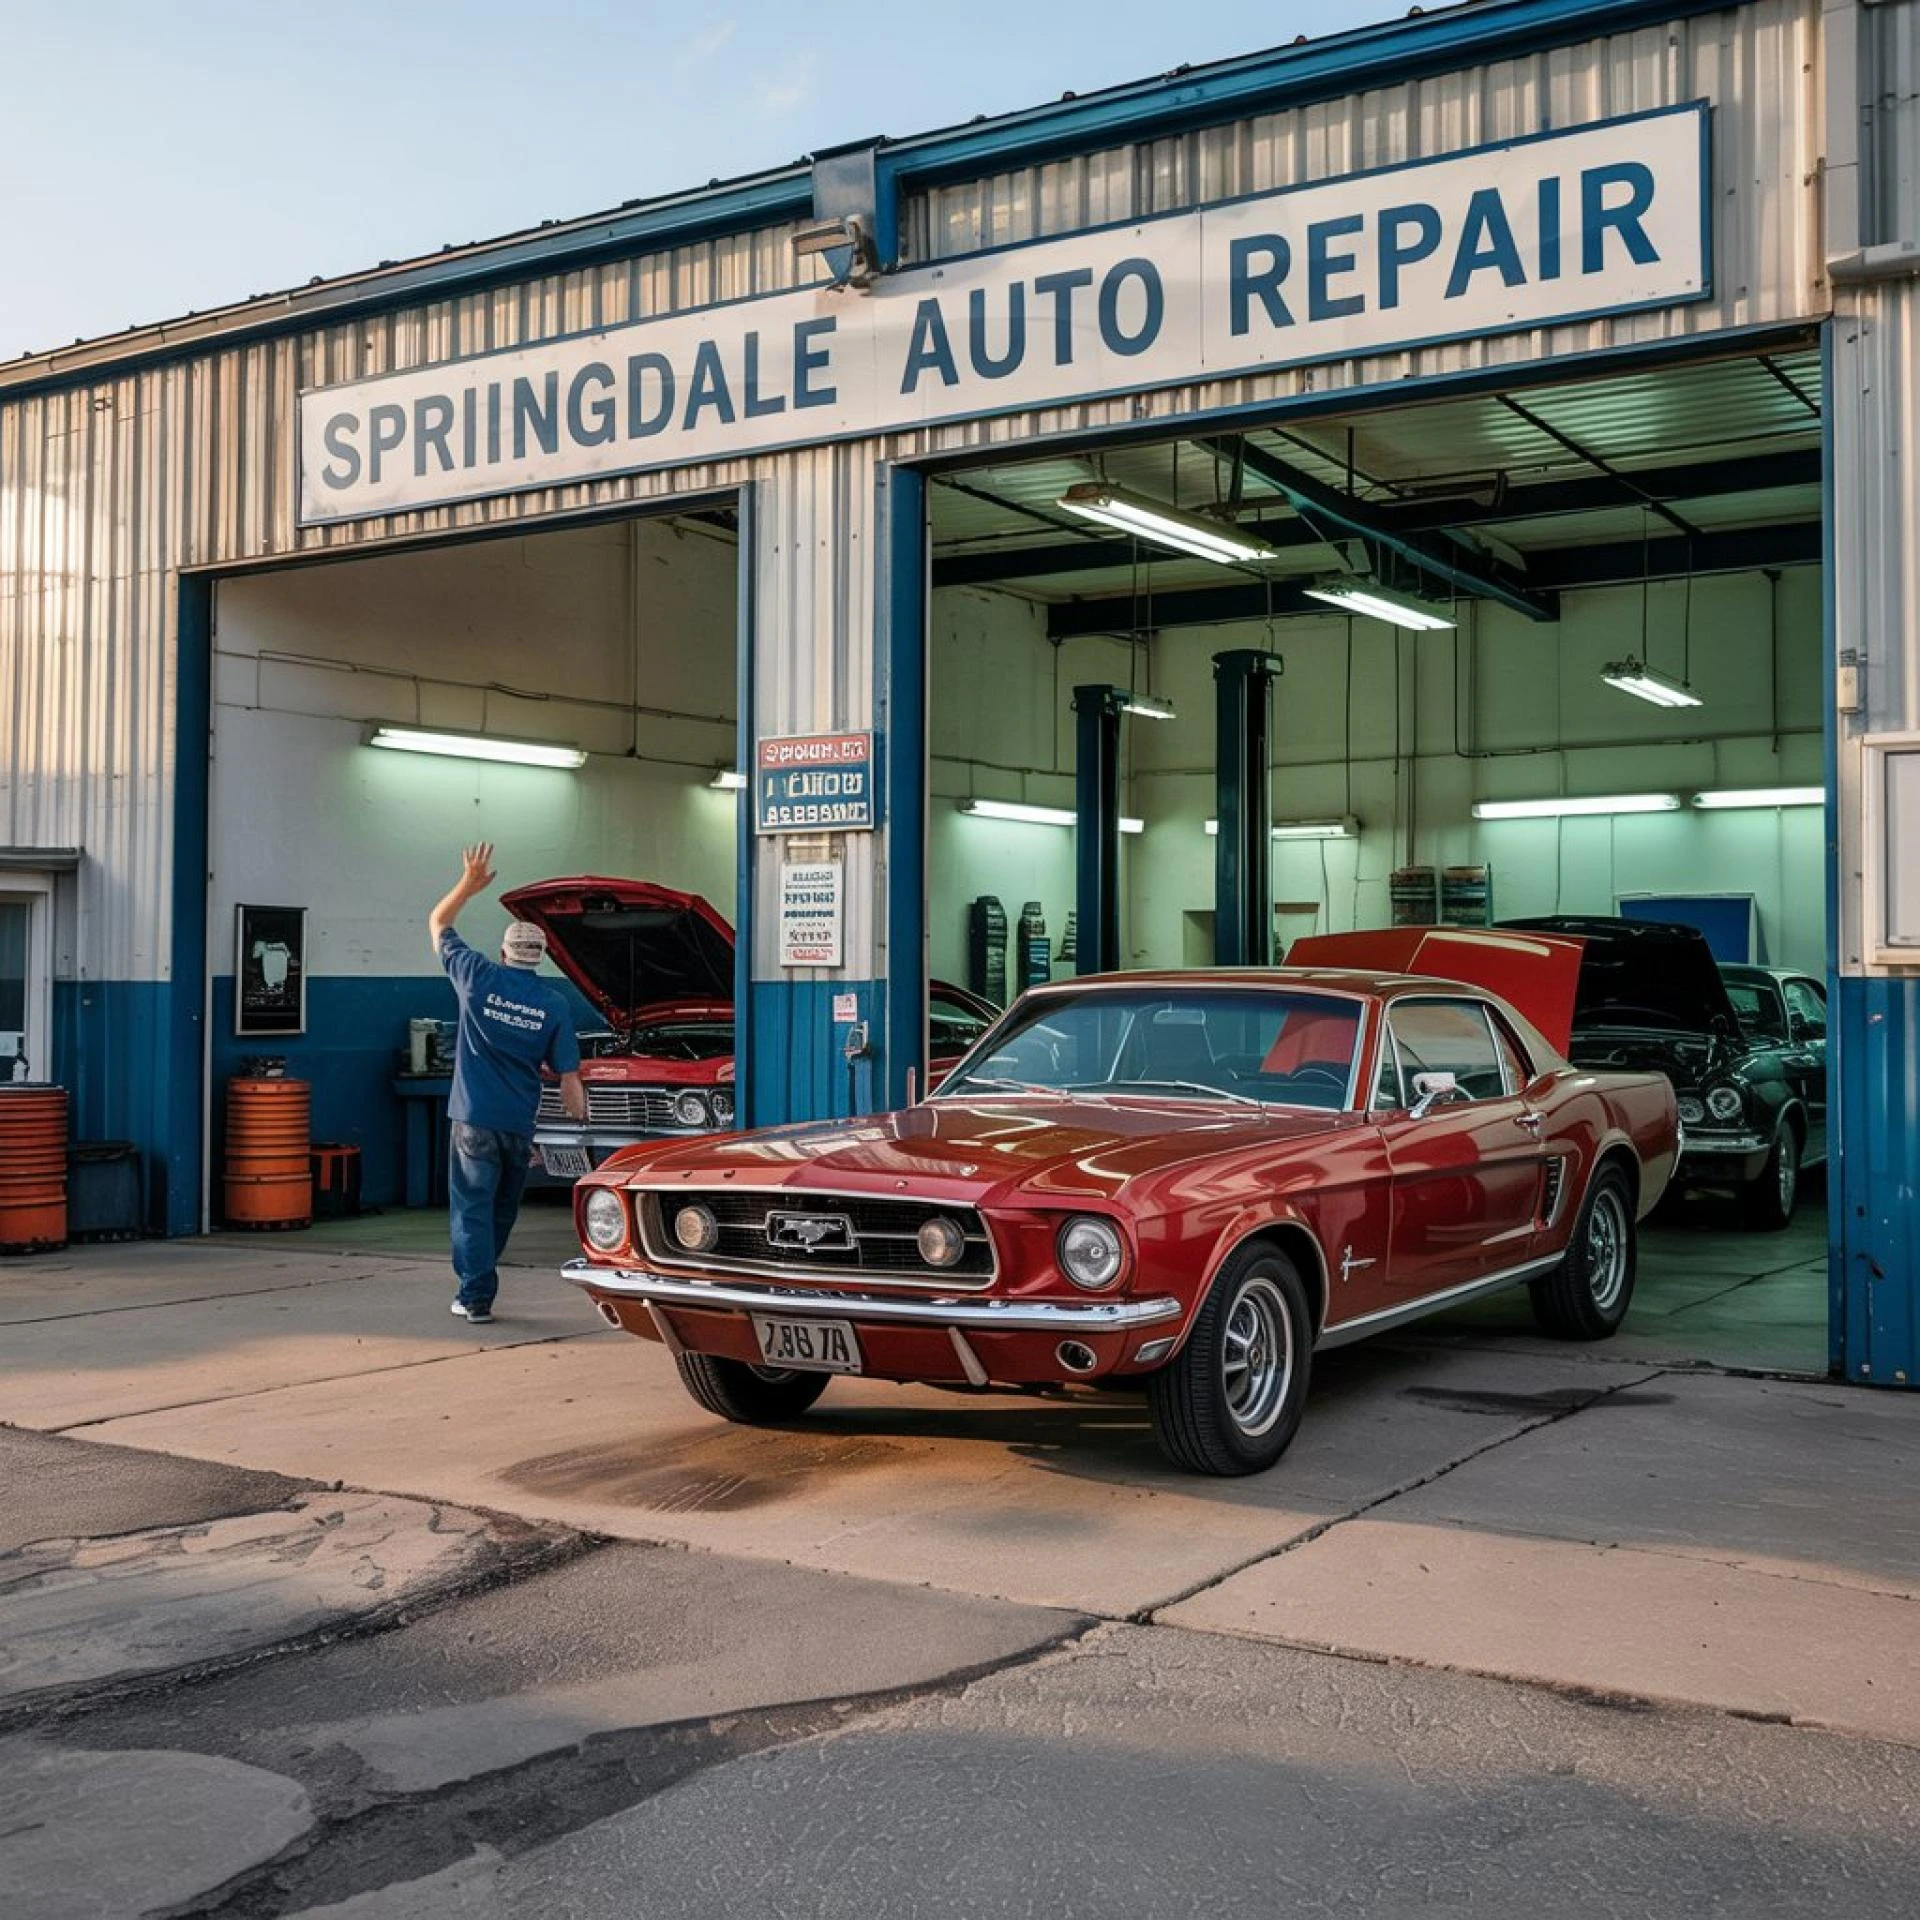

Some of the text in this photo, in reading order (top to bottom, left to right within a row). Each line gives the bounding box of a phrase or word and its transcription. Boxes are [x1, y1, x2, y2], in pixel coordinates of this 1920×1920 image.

[322, 161, 1662, 490] SPRIINGDALE AUTO REPAIR
